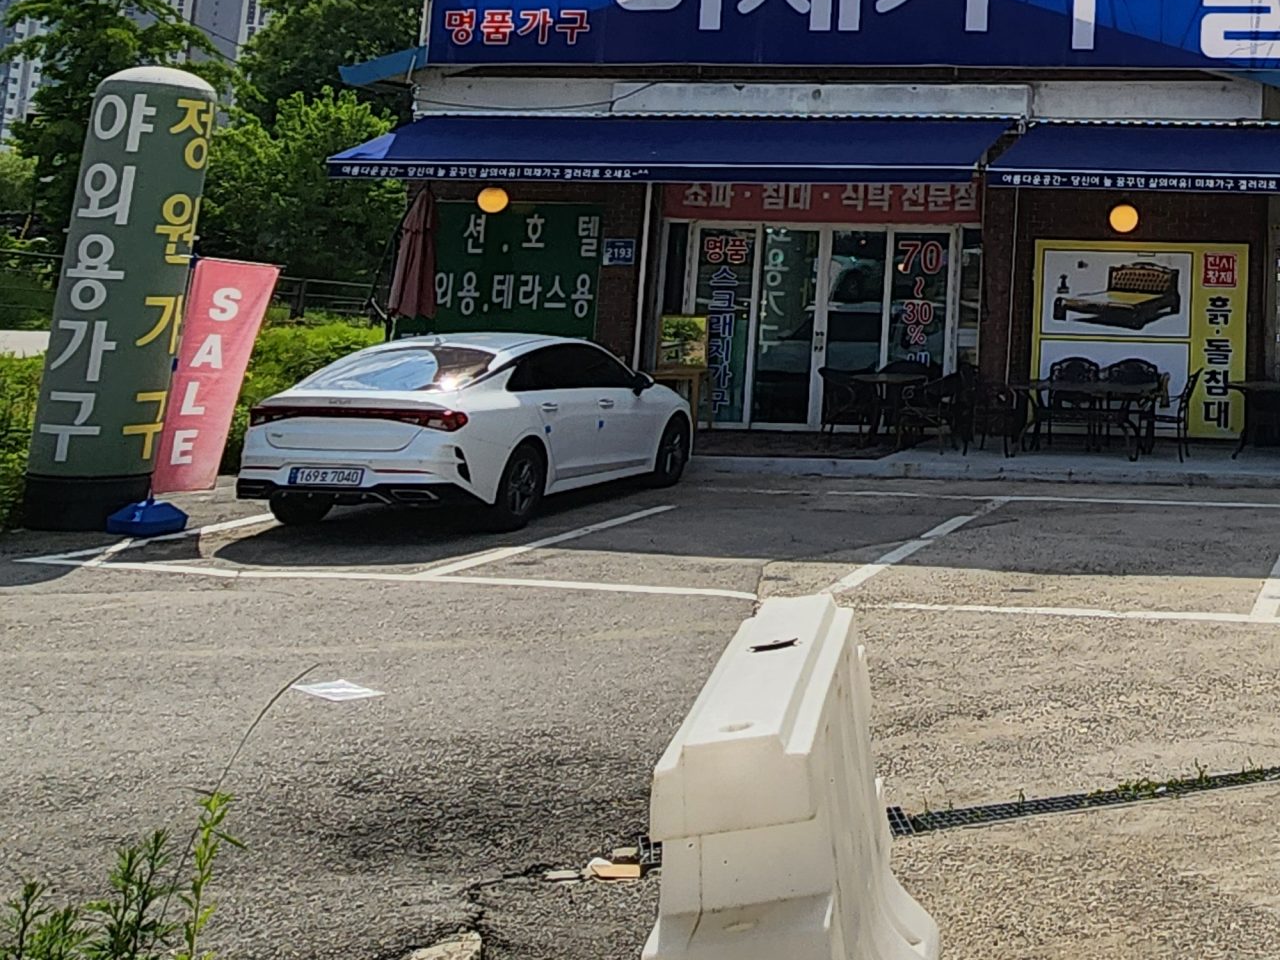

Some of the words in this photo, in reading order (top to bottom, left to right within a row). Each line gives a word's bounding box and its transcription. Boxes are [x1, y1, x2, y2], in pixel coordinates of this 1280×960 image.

[444, 8, 592, 46] 명품가구
[840, 183, 893, 212] 식탁
[901, 183, 977, 212] 전문점
[606, 247, 632, 259] 2193
[704, 235, 749, 265] 명품
[898, 240, 945, 277] 70
[169, 287, 242, 467] SALE
[331, 470, 360, 483] 7040
